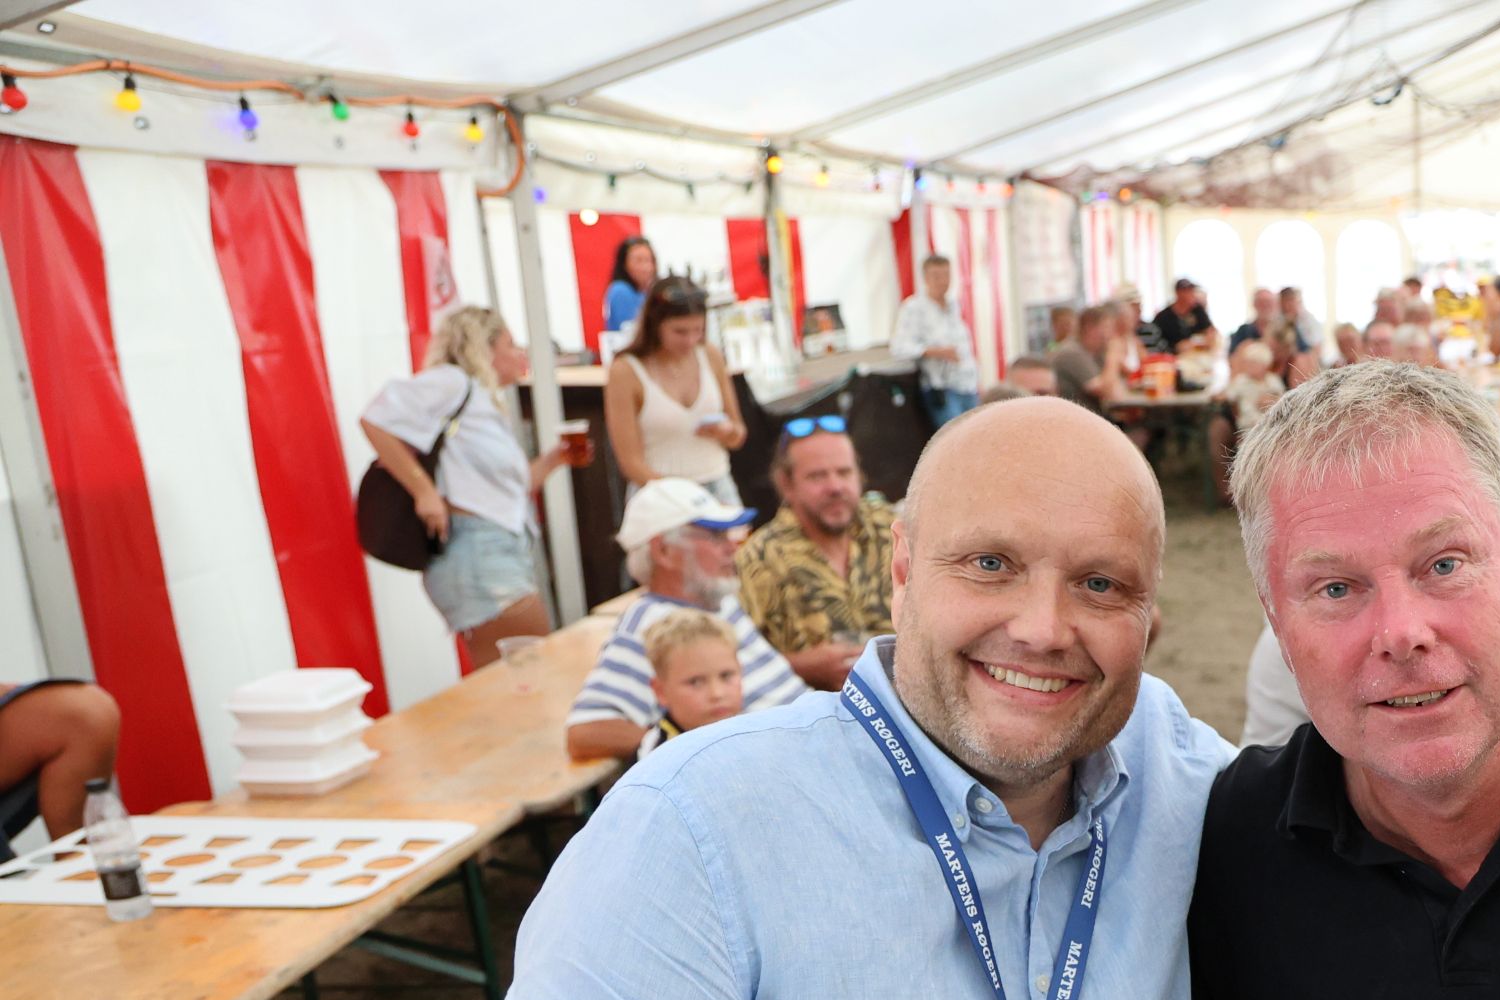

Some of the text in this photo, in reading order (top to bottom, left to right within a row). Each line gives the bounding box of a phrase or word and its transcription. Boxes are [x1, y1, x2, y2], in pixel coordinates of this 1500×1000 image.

[870, 718, 916, 777] RØGERI
[1081, 843, 1103, 909] RØGERI
[935, 832, 1001, 990] MARTENS RØGERI
